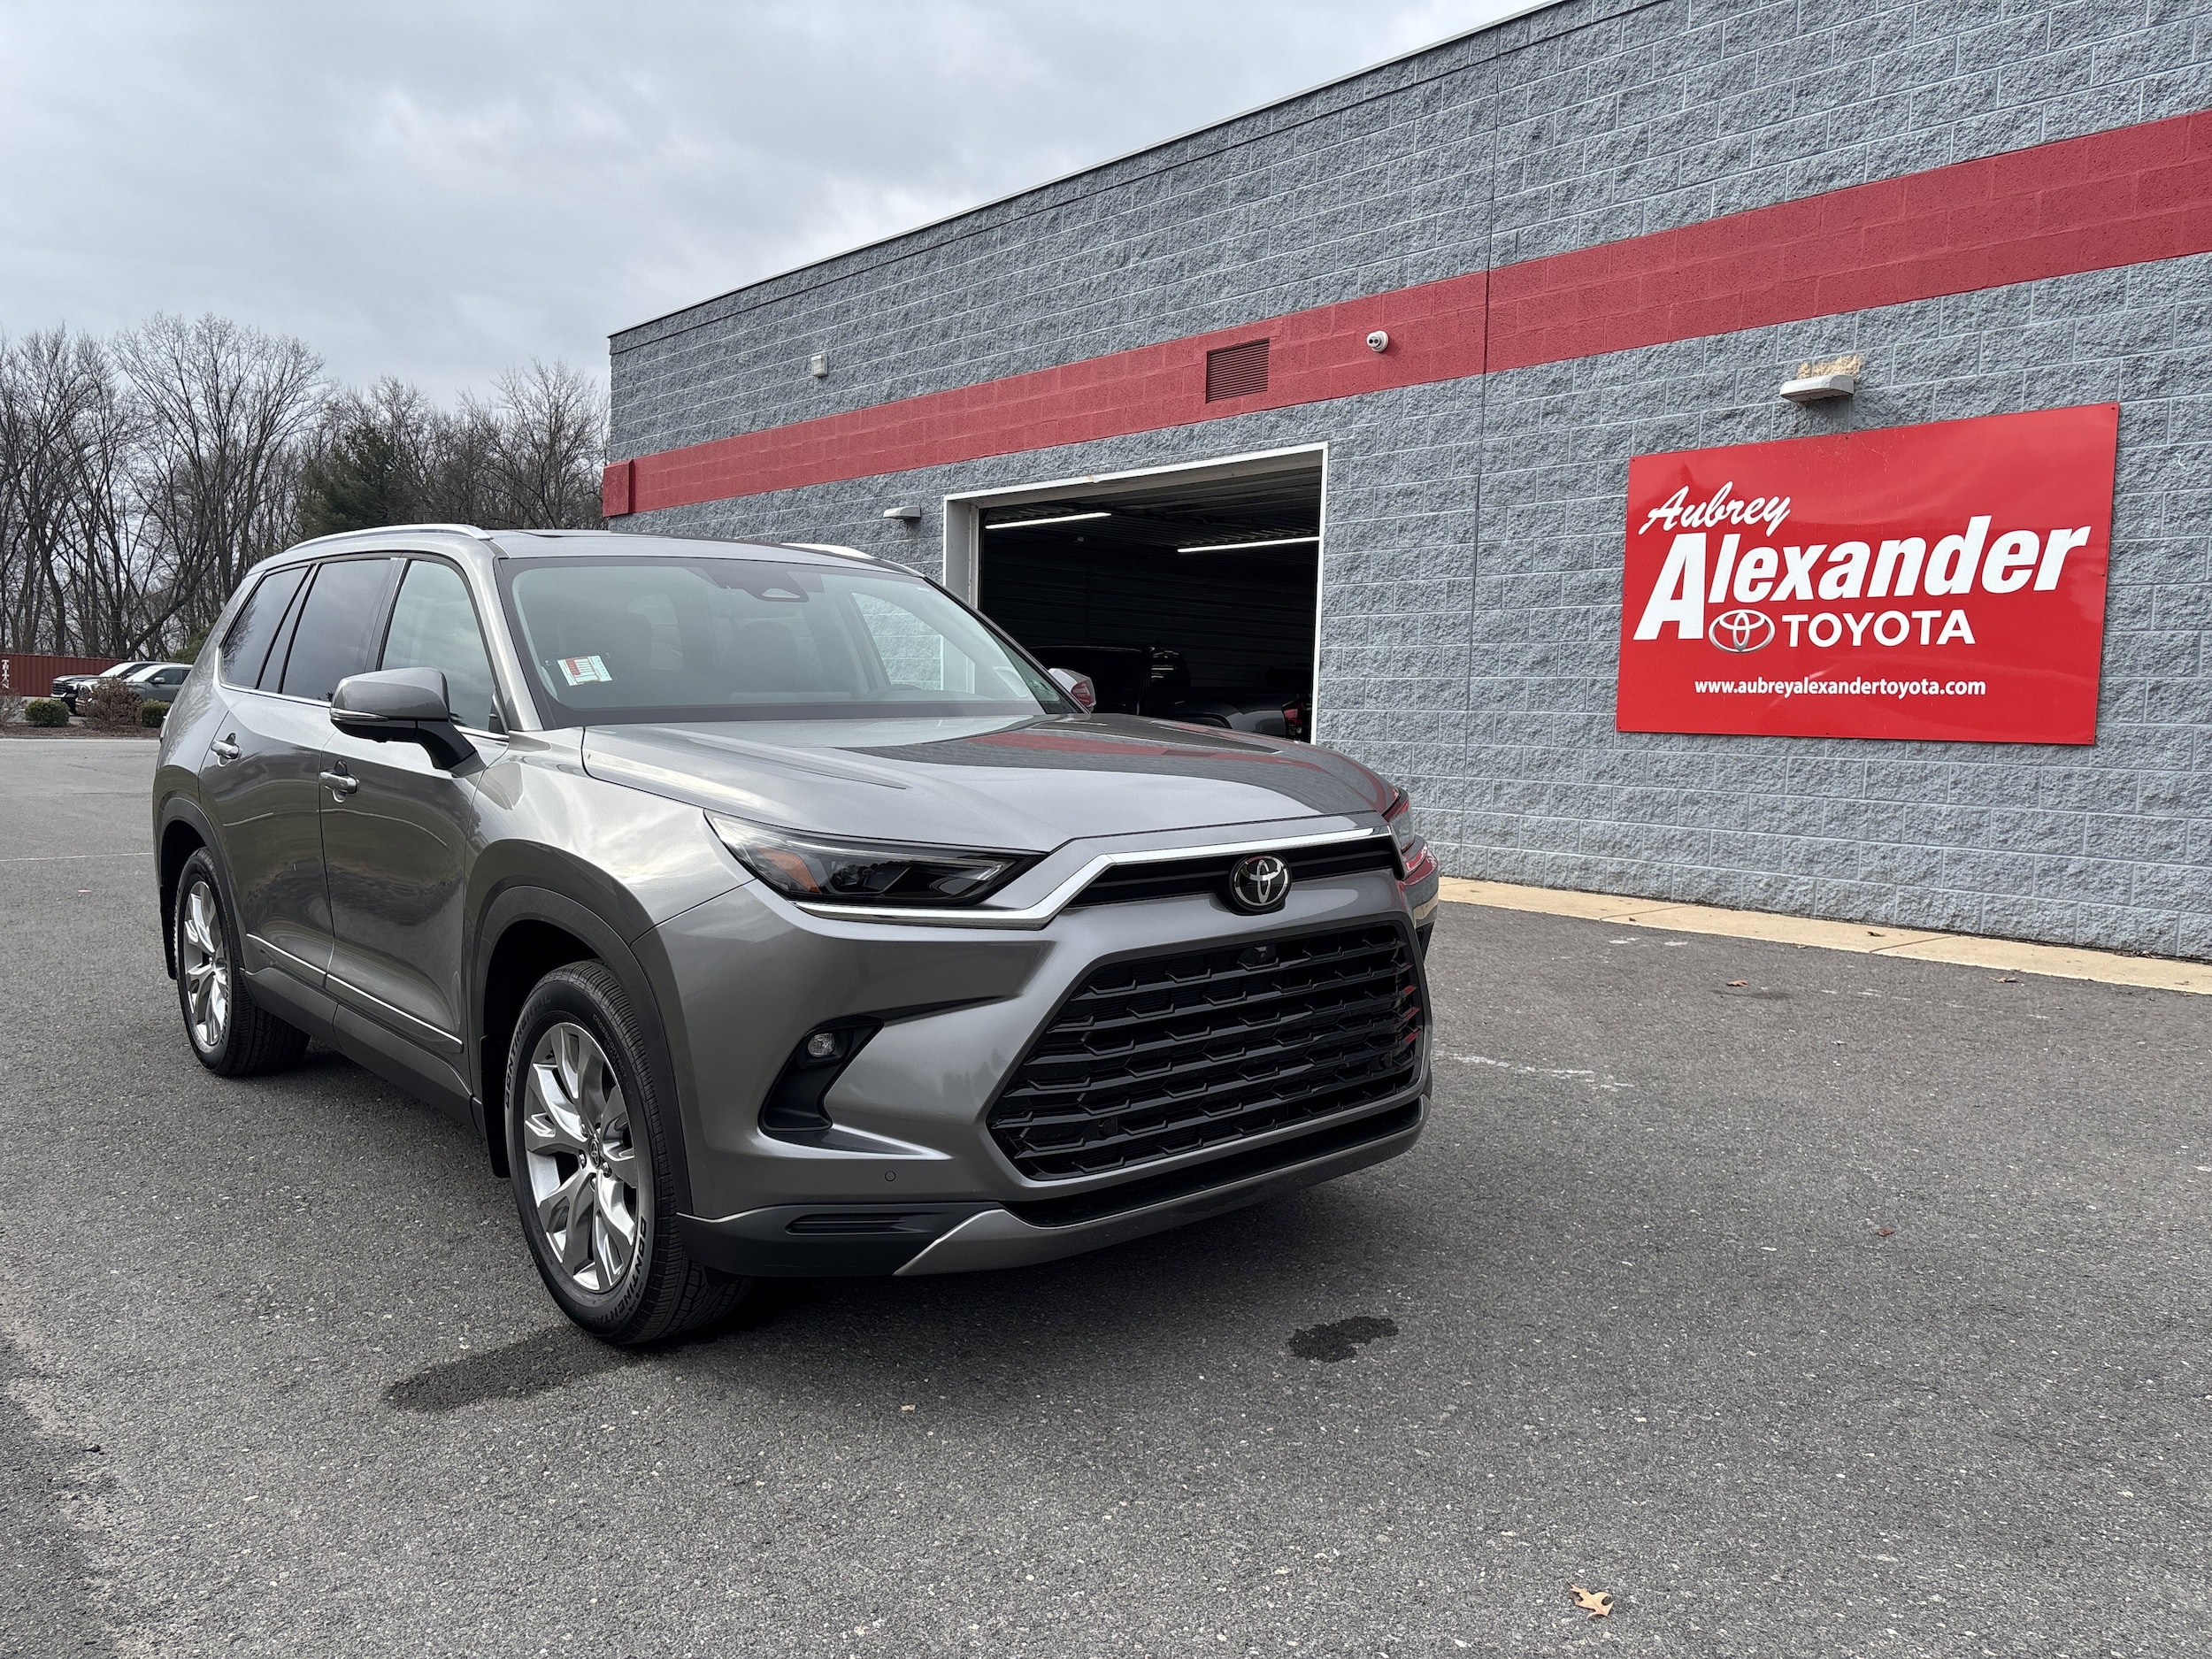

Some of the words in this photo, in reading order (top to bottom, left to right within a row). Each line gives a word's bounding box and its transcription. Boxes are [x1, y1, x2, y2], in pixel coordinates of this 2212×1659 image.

[1639, 481, 1791, 536] Aubrey
[1633, 515, 2092, 641] Alexander
[1782, 609, 1975, 648] TOYOTA
[1694, 676, 1985, 700] www.aubreyalexandertoyota.com
